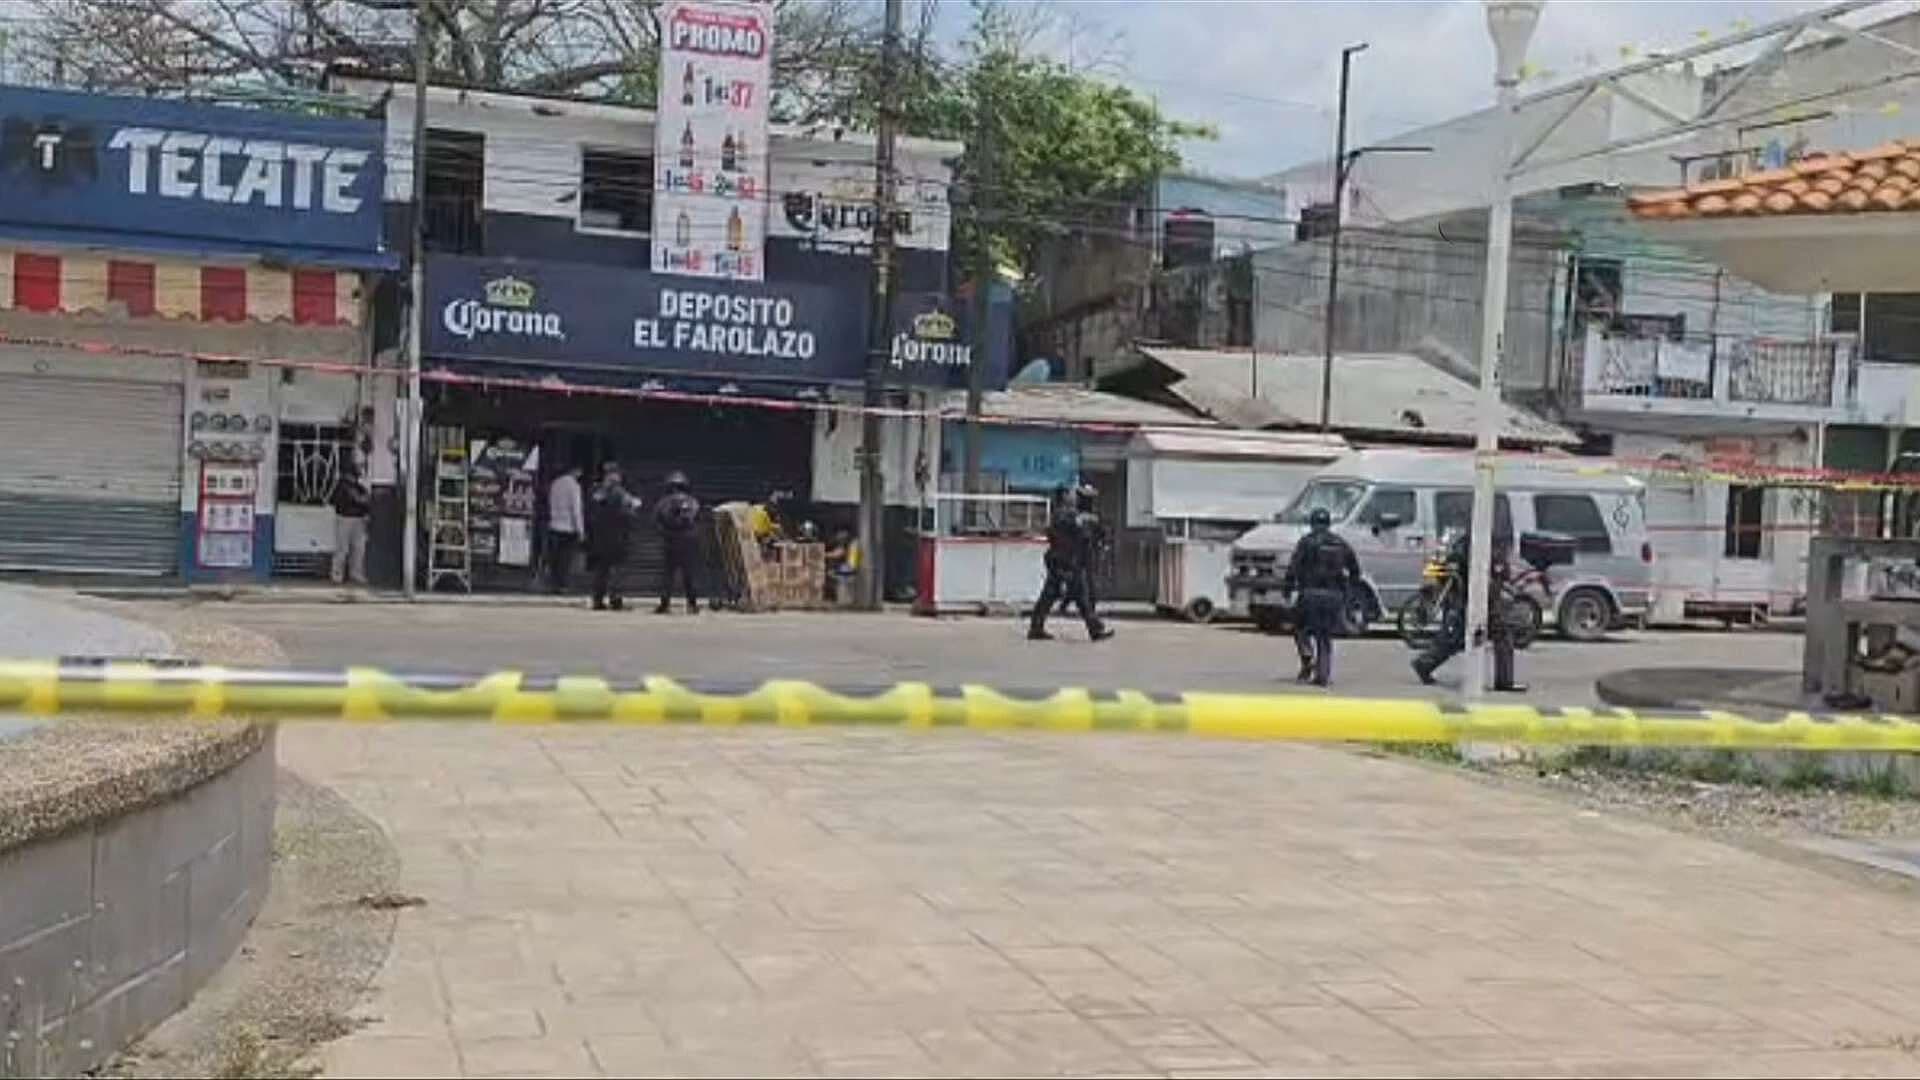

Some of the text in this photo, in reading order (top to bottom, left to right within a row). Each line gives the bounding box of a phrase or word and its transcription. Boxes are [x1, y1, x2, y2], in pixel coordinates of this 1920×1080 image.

[673, 22, 761, 56] PROMO
[108, 127, 372, 213] TECATE
[784, 192, 913, 235] Coroa
[444, 299, 565, 339] Corona
[660, 289, 793, 327] DEPOSITO
[633, 318, 816, 359] EL FAROLAZO
